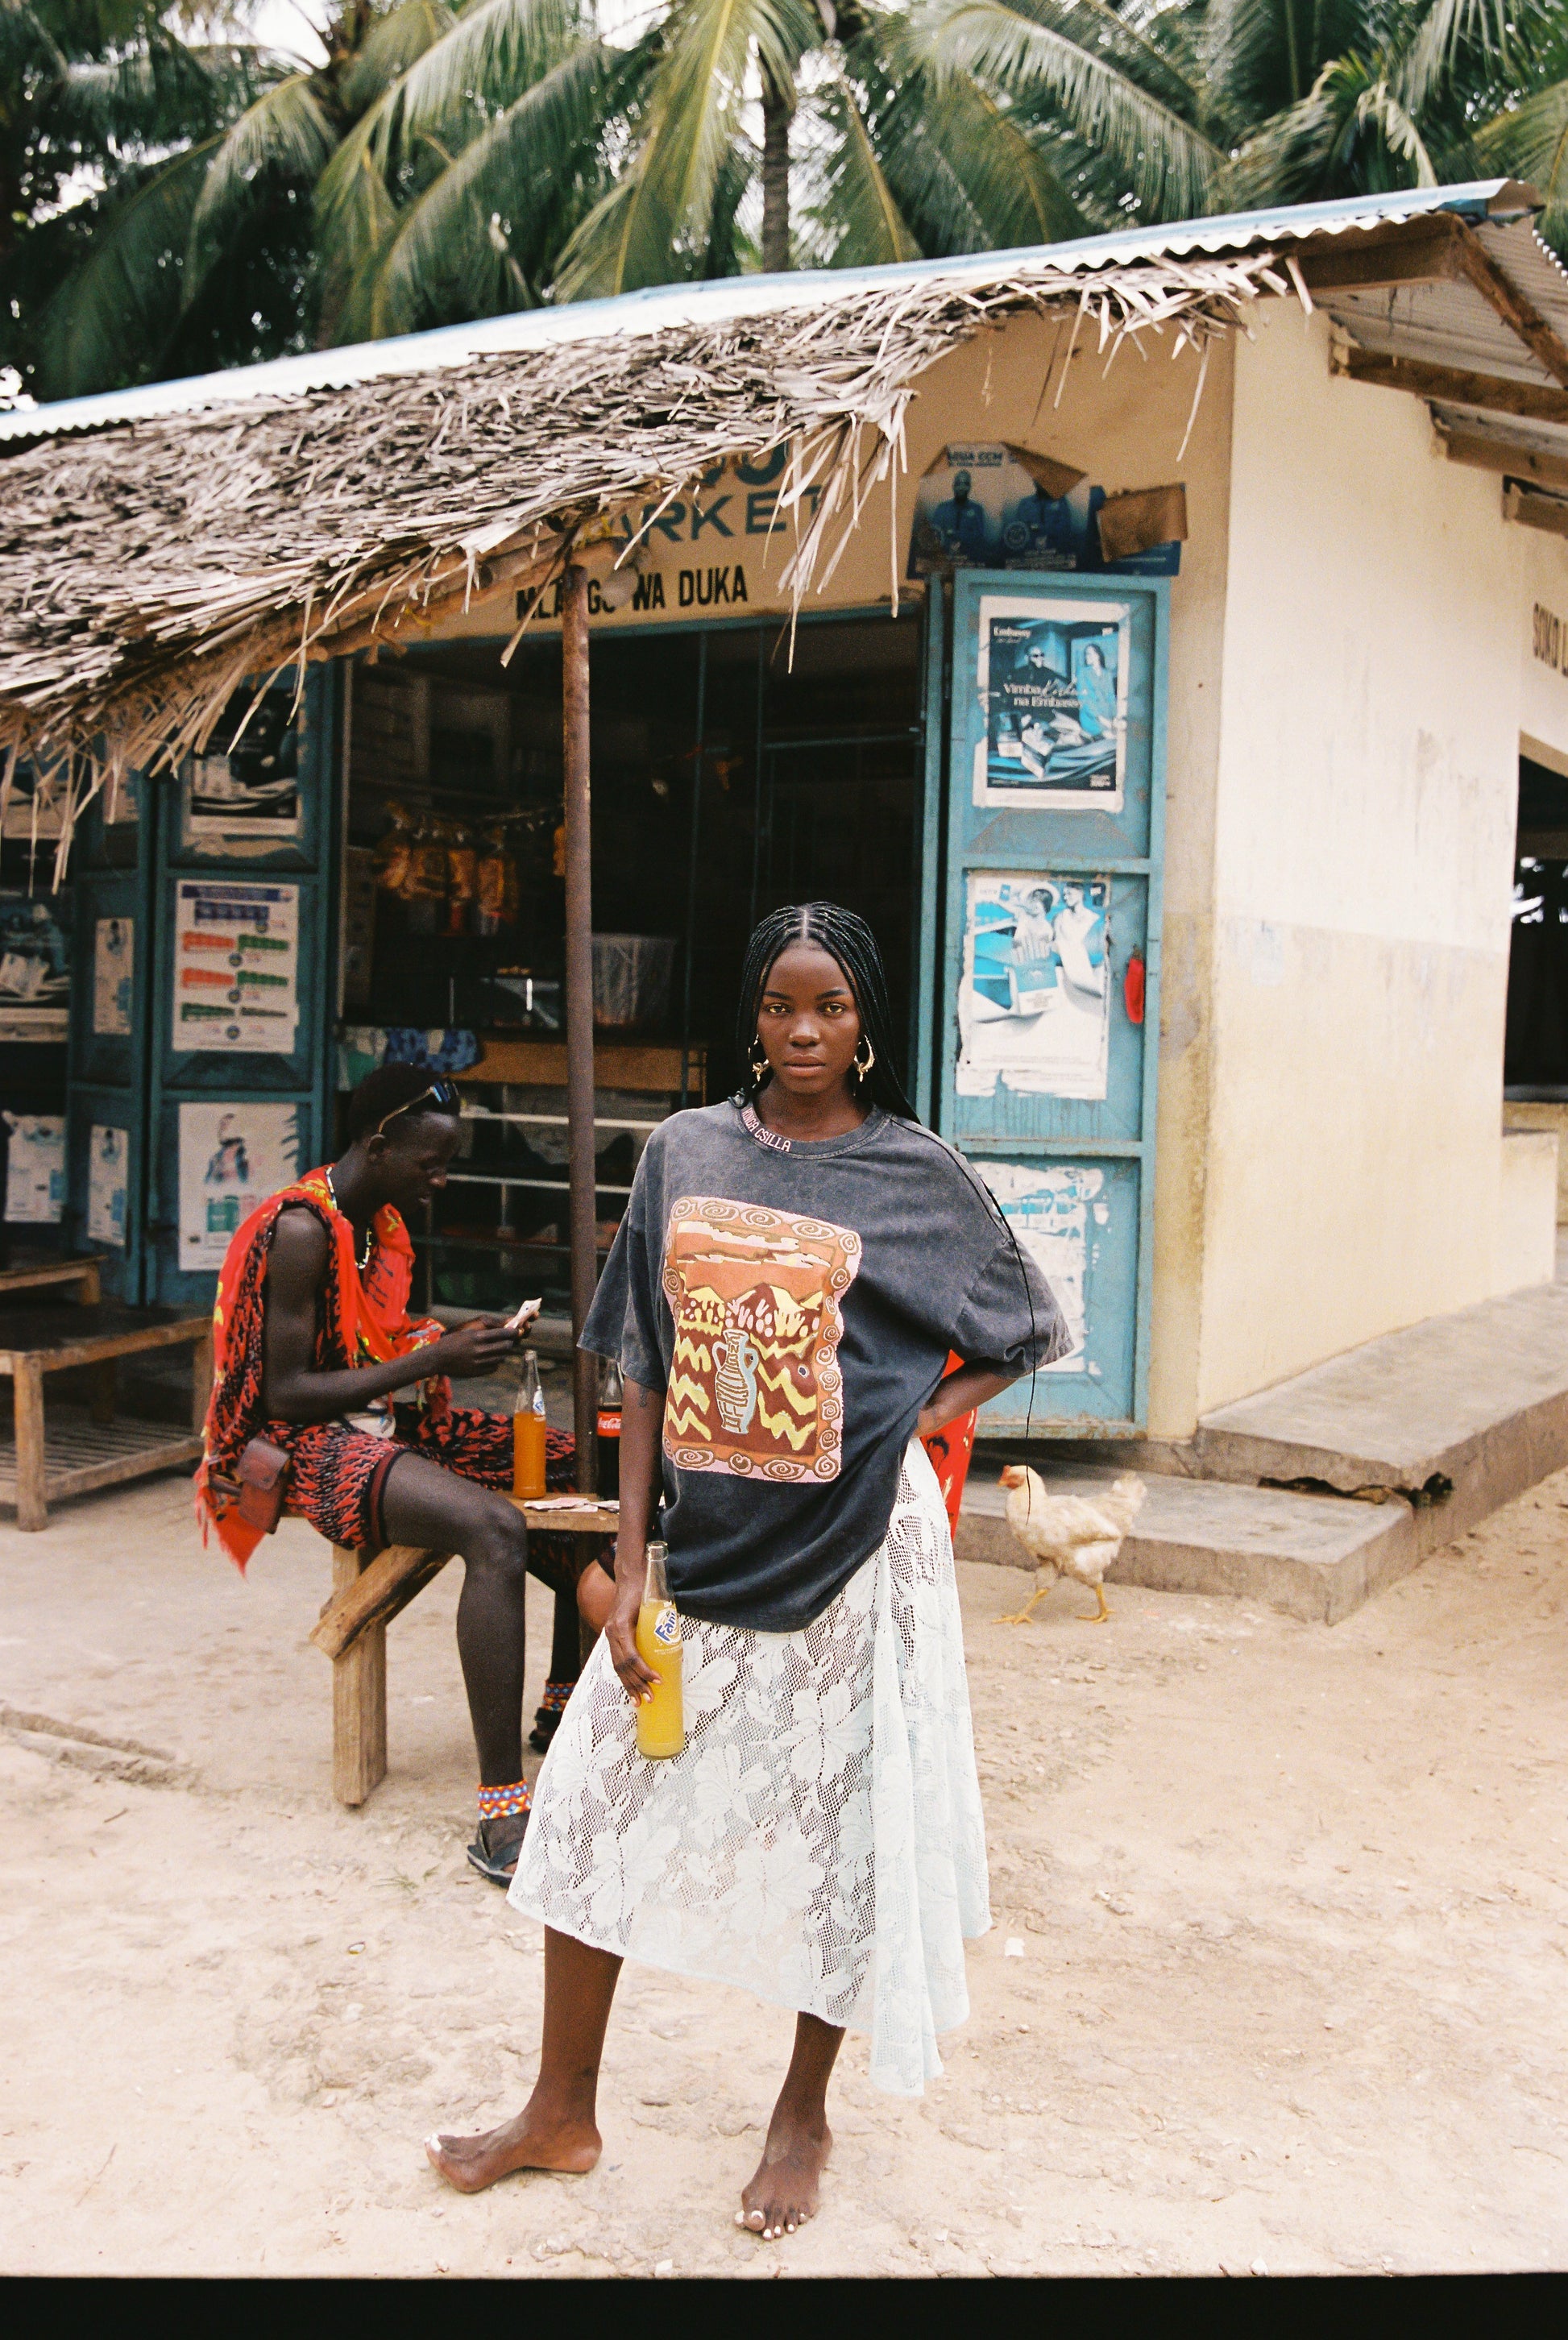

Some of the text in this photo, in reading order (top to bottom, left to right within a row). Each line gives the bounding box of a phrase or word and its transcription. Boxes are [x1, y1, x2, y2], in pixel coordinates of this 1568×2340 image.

[516, 565, 748, 620] MLAG WA DUKA
[754, 1127, 791, 1152] CSILLA
